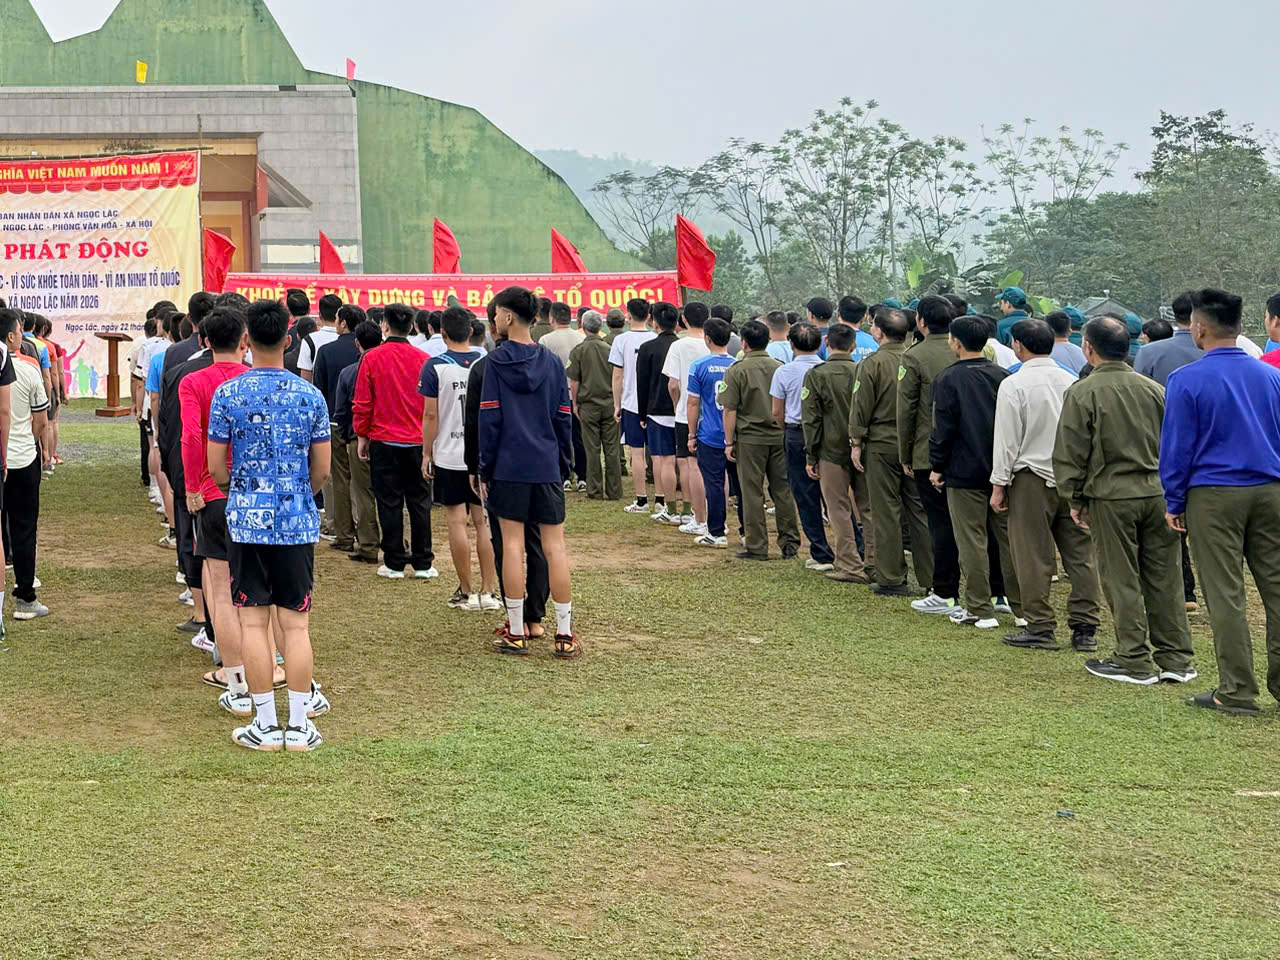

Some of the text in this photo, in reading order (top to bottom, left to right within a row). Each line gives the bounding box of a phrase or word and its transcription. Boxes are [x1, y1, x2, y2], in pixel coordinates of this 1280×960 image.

[27, 166, 54, 182] VIỆT
[57, 166, 86, 179] NAM
[90, 163, 128, 177] MUÔN
[131, 161, 161, 175] NĂM
[17, 211, 41, 220] NHÂN
[4, 239, 71, 260] PHÁT
[78, 236, 149, 263] ĐỘNG
[11, 271, 18, 289] VÌ
[20, 272, 36, 289] SỨC
[60, 271, 80, 289] TOÀN
[82, 271, 98, 288] DÂN
[105, 270, 112, 288] VÌ
[115, 273, 126, 287] AN
[127, 272, 147, 287] NINH
[160, 267, 180, 287] QUỐC
[8, 292, 99, 312] XÃ NGỌC LẶC NĂM 2026
[467, 284, 496, 307] BẢ
[553, 282, 583, 308] TỔ
[120, 323, 129, 331] 22
